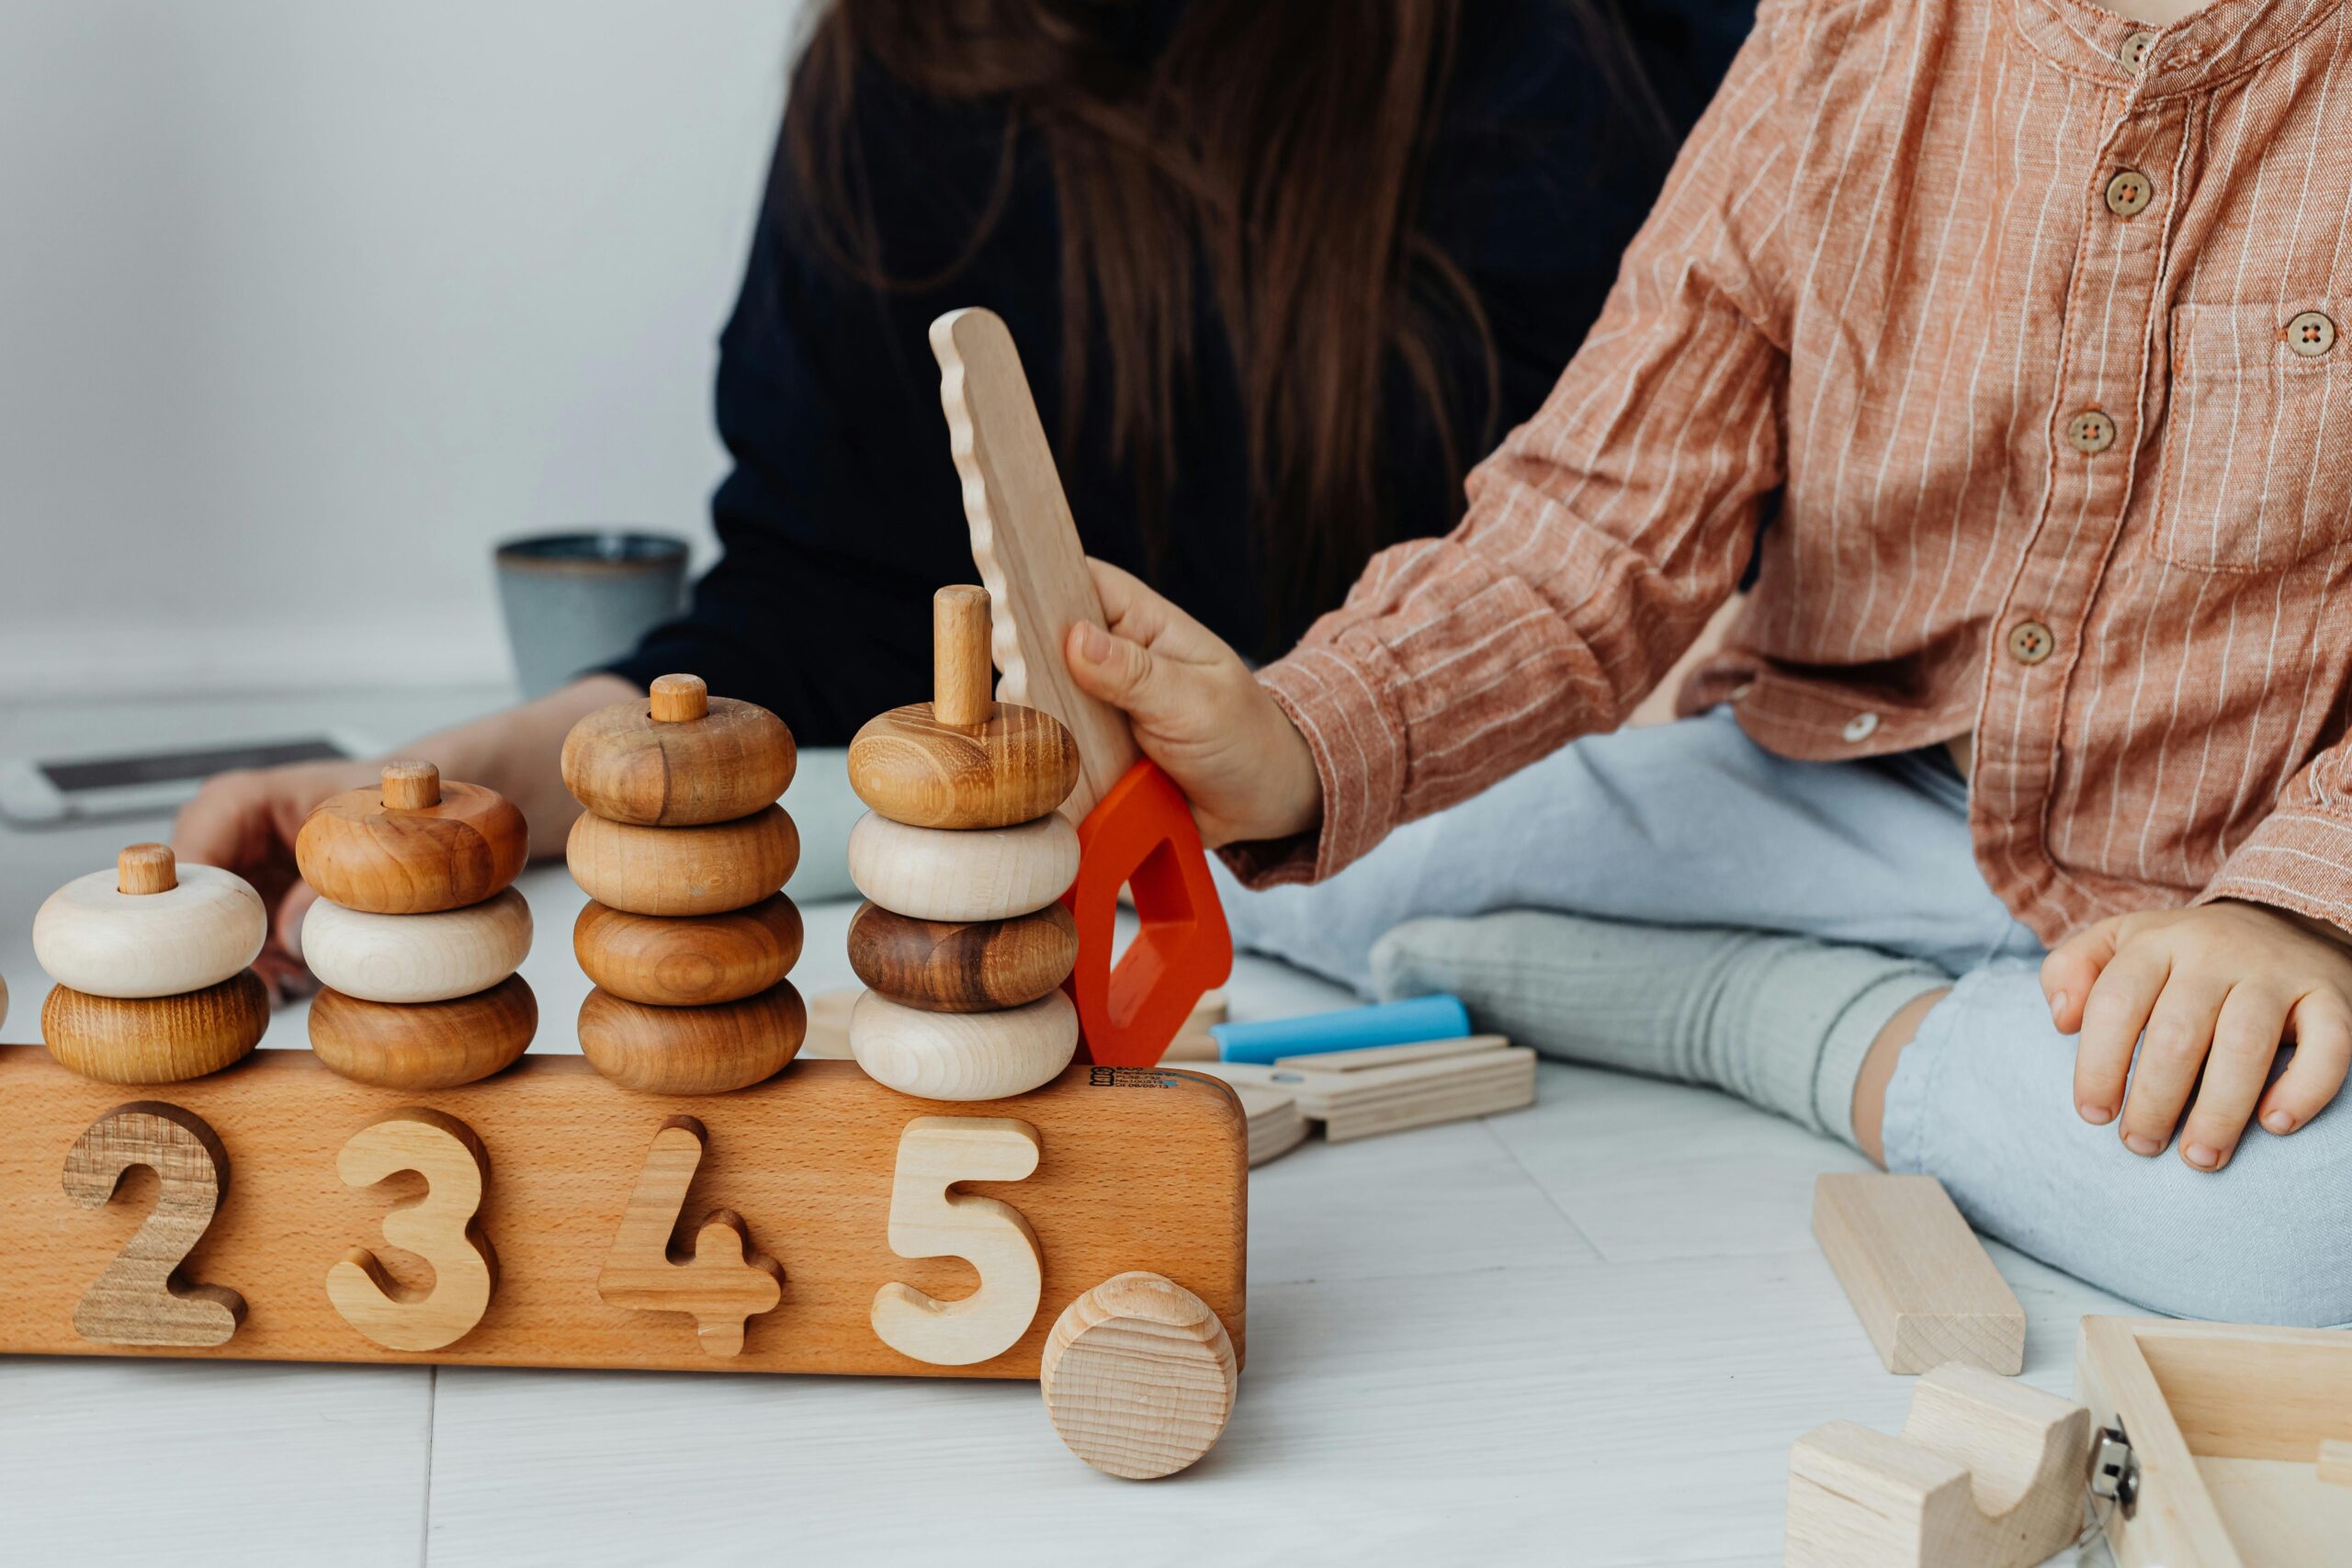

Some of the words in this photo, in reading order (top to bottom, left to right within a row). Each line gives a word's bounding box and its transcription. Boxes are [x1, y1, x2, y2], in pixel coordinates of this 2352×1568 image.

[62, 1101, 248, 1348] 2
[326, 1108, 497, 1352] 3
[598, 1114, 784, 1358] 4
[870, 1116, 1043, 1366] 5
